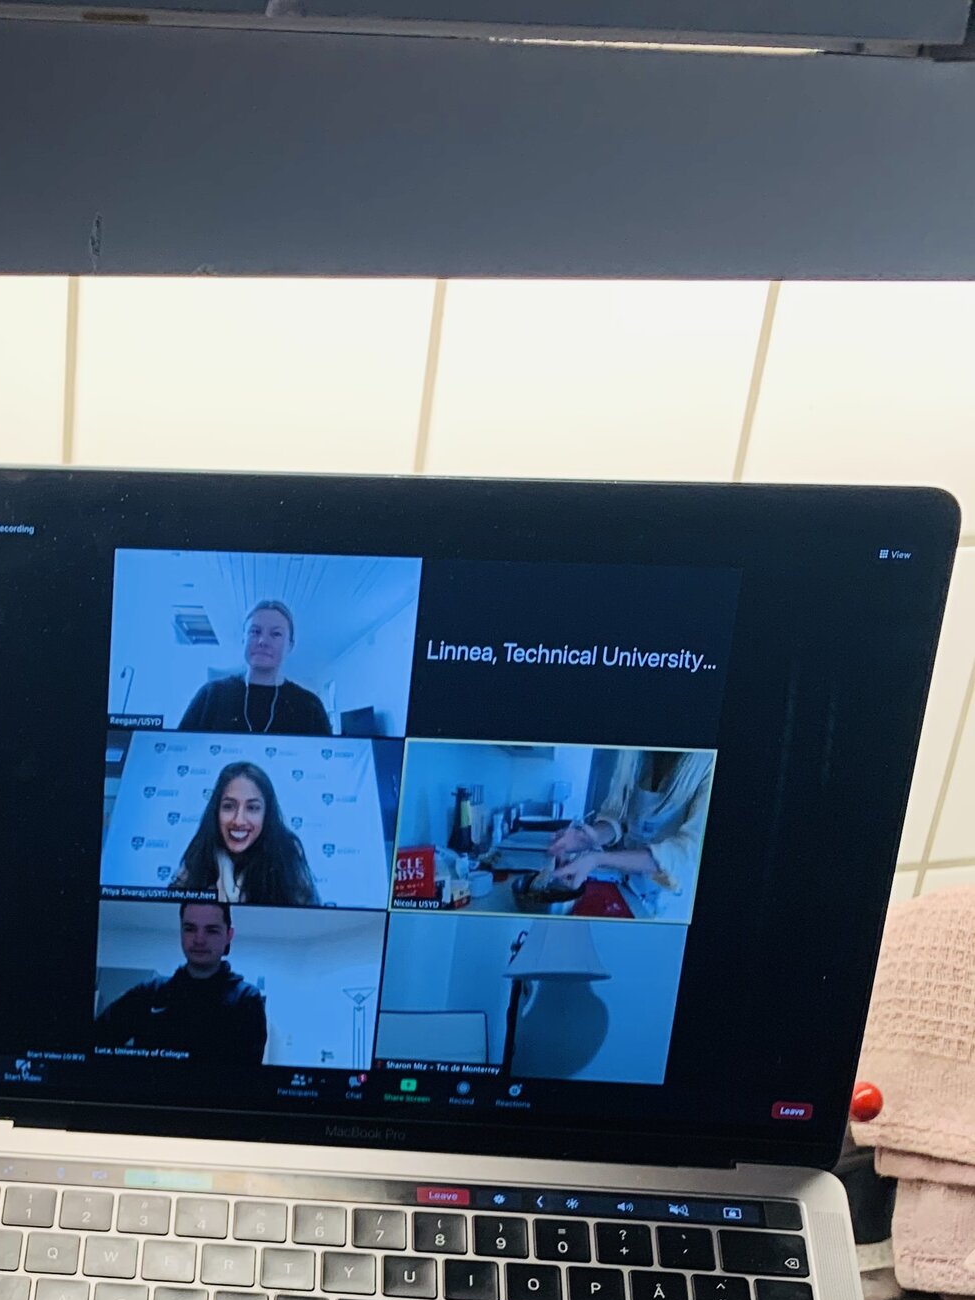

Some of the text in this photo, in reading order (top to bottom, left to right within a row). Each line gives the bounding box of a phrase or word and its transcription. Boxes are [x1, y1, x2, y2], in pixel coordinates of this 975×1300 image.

[890, 549, 912, 561] View
[426, 639, 717, 673] Linnea, Technical University...
[109, 716, 162, 727] Reegan/USYD
[101, 887, 120, 897] Priya
[393, 899, 440, 909] Nicola USYD
[115, 1047, 149, 1058] University
[151, 1048, 159, 1057] of
[160, 1048, 190, 1060] Cologne
[386, 1060, 412, 1070] Sharon
[451, 1064, 460, 1073] de
[461, 1064, 500, 1075] Monterrey
[384, 1093, 430, 1103] Share Screen
[779, 1106, 805, 1116] Leave
[326, 1125, 406, 1140] MacBook Pro
[428, 1190, 458, 1201] Leave
[81, 1211, 91, 1223] 2
[138, 1214, 149, 1227] 3
[314, 1226, 325, 1239] 6
[375, 1229, 385, 1242] 7
[434, 1233, 445, 1246] 8
[495, 1236, 507, 1250] 9
[46, 1247, 59, 1260] Q
[104, 1250, 119, 1263] W
[224, 1259, 234, 1270] R
[283, 1263, 294, 1274] T
[343, 1265, 355, 1279] Y
[403, 1270, 416, 1283] U
[590, 1281, 602, 1294] P
[653, 1282, 666, 1300] Å
